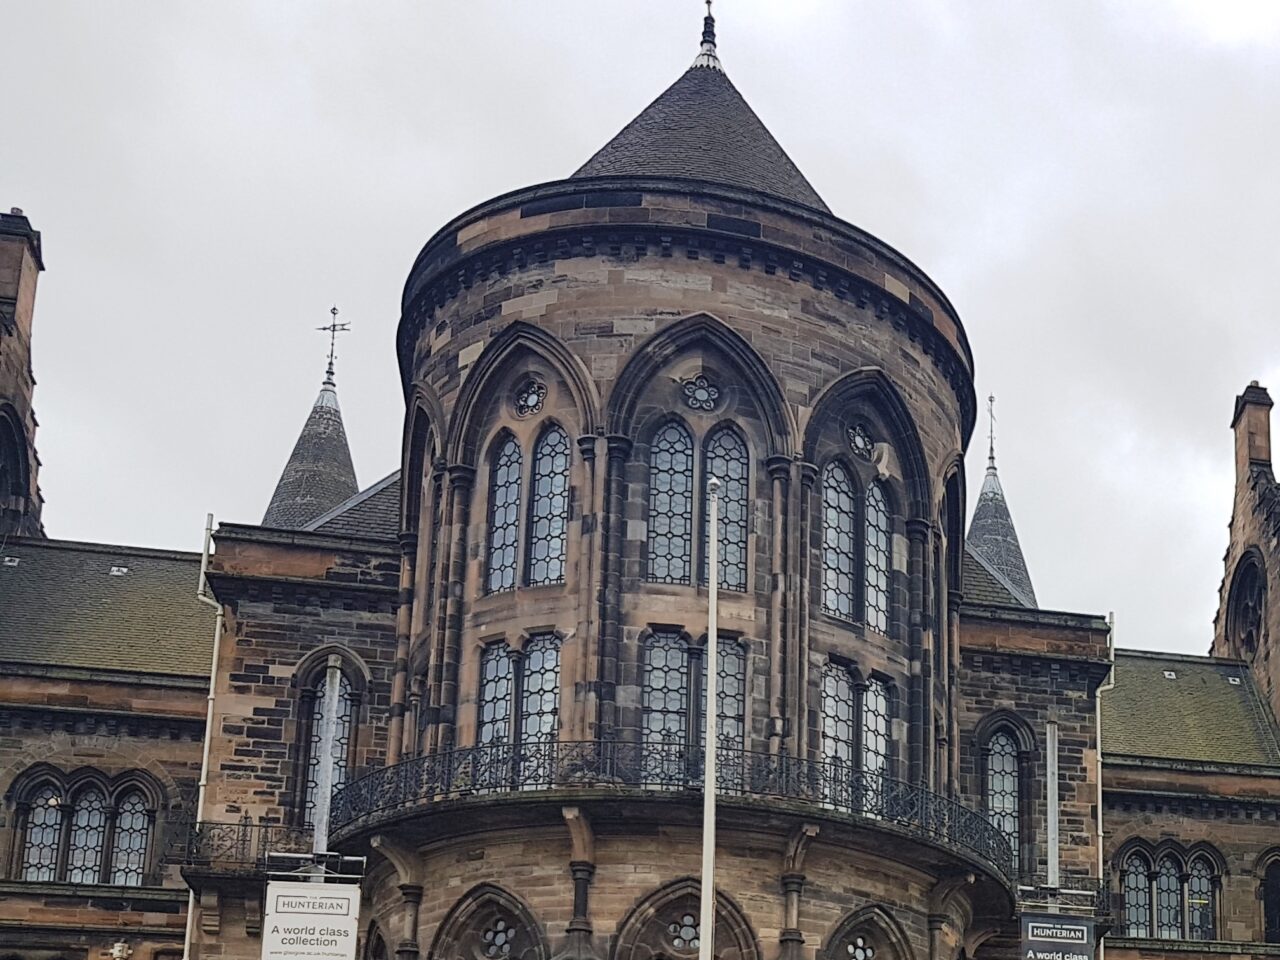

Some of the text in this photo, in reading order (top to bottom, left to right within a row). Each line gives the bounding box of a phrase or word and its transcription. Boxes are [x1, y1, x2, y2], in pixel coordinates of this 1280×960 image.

[282, 900, 343, 910] HUNTERIAN
[271, 925, 349, 937] A world class
[1033, 928, 1082, 939] HUNTERIAN
[281, 936, 337, 947] collection
[1026, 949, 1035, 959] A
[1036, 951, 1062, 960] world
